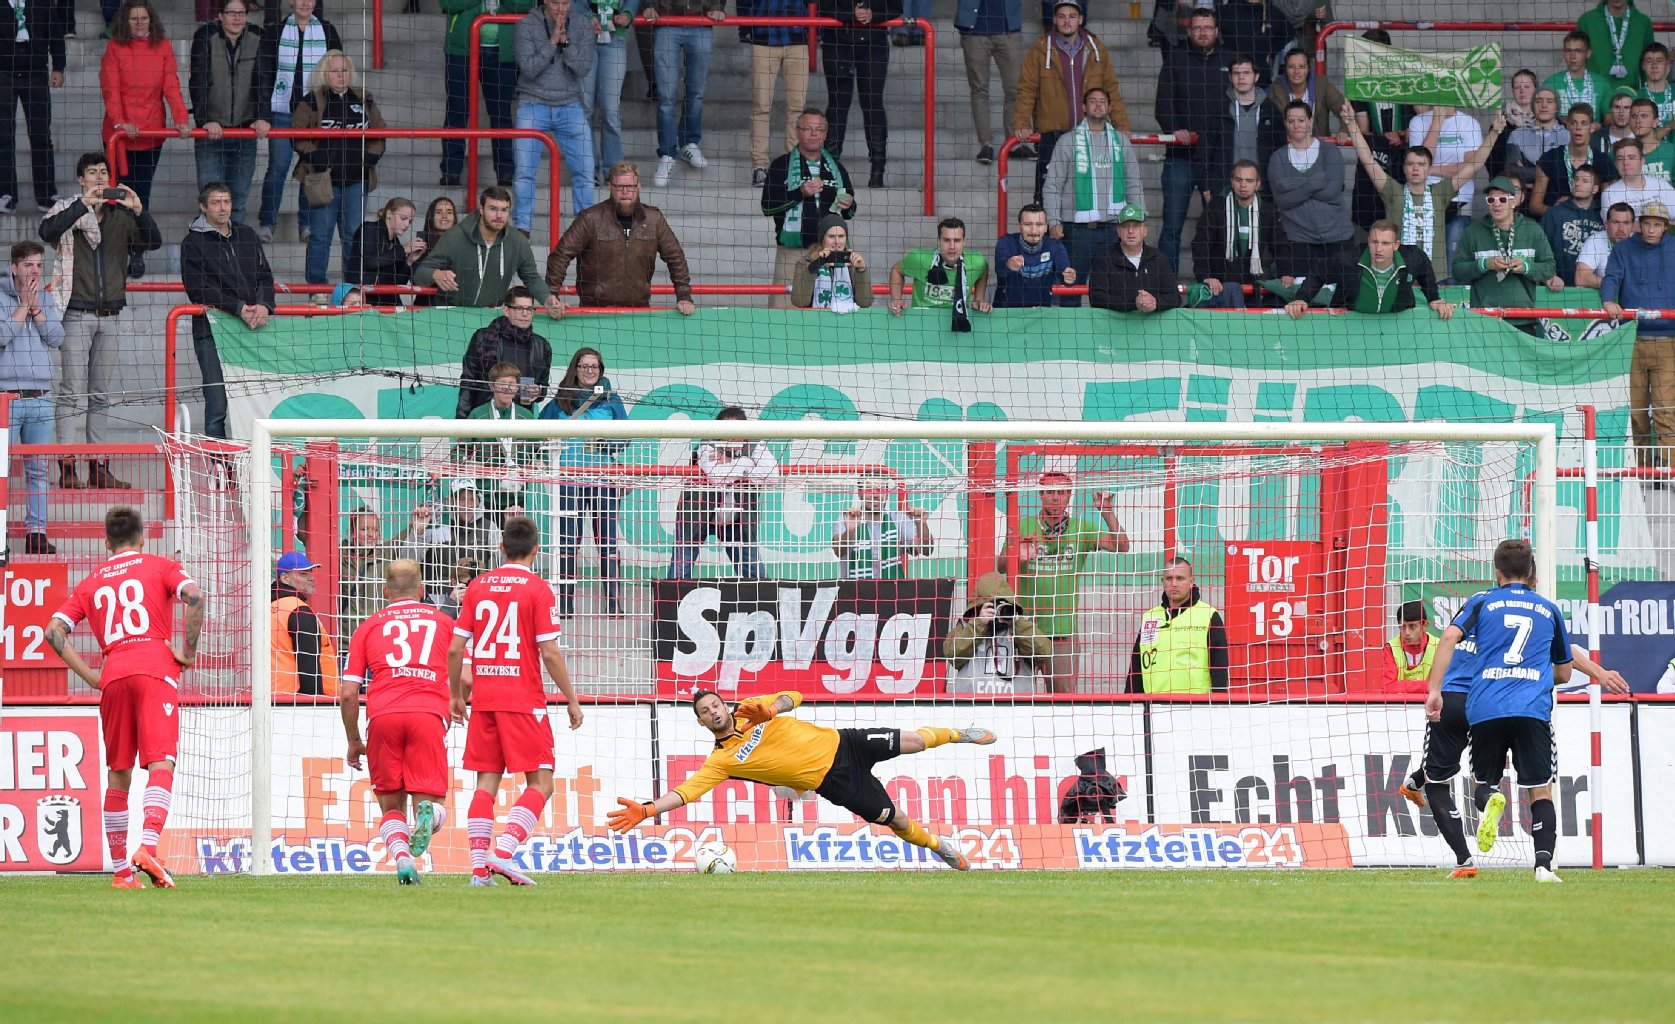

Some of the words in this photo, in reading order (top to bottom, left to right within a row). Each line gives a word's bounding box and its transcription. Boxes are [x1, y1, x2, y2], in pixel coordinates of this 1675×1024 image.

[1356, 72, 1459, 99] verde
[113, 557, 143, 570] UNION
[487, 576, 498, 584] FC
[501, 576, 529, 584] UNION
[1243, 548, 1299, 583] Tor
[94, 579, 150, 645] 28
[402, 607, 434, 615] UNION
[1250, 601, 1293, 636] 13
[3, 625, 45, 660] 12
[382, 619, 438, 668] 37
[474, 600, 521, 660] 24
[671, 586, 932, 694] SpVgg
[1503, 614, 1533, 665] 7
[391, 666, 437, 682] LEISTNER
[475, 665, 521, 677] SKRZYBSKI
[867, 732, 890, 741] 1
[853, 774, 967, 824] on
[1188, 755, 1345, 823] Echt
[1080, 833, 1296, 864] kfzteile24
